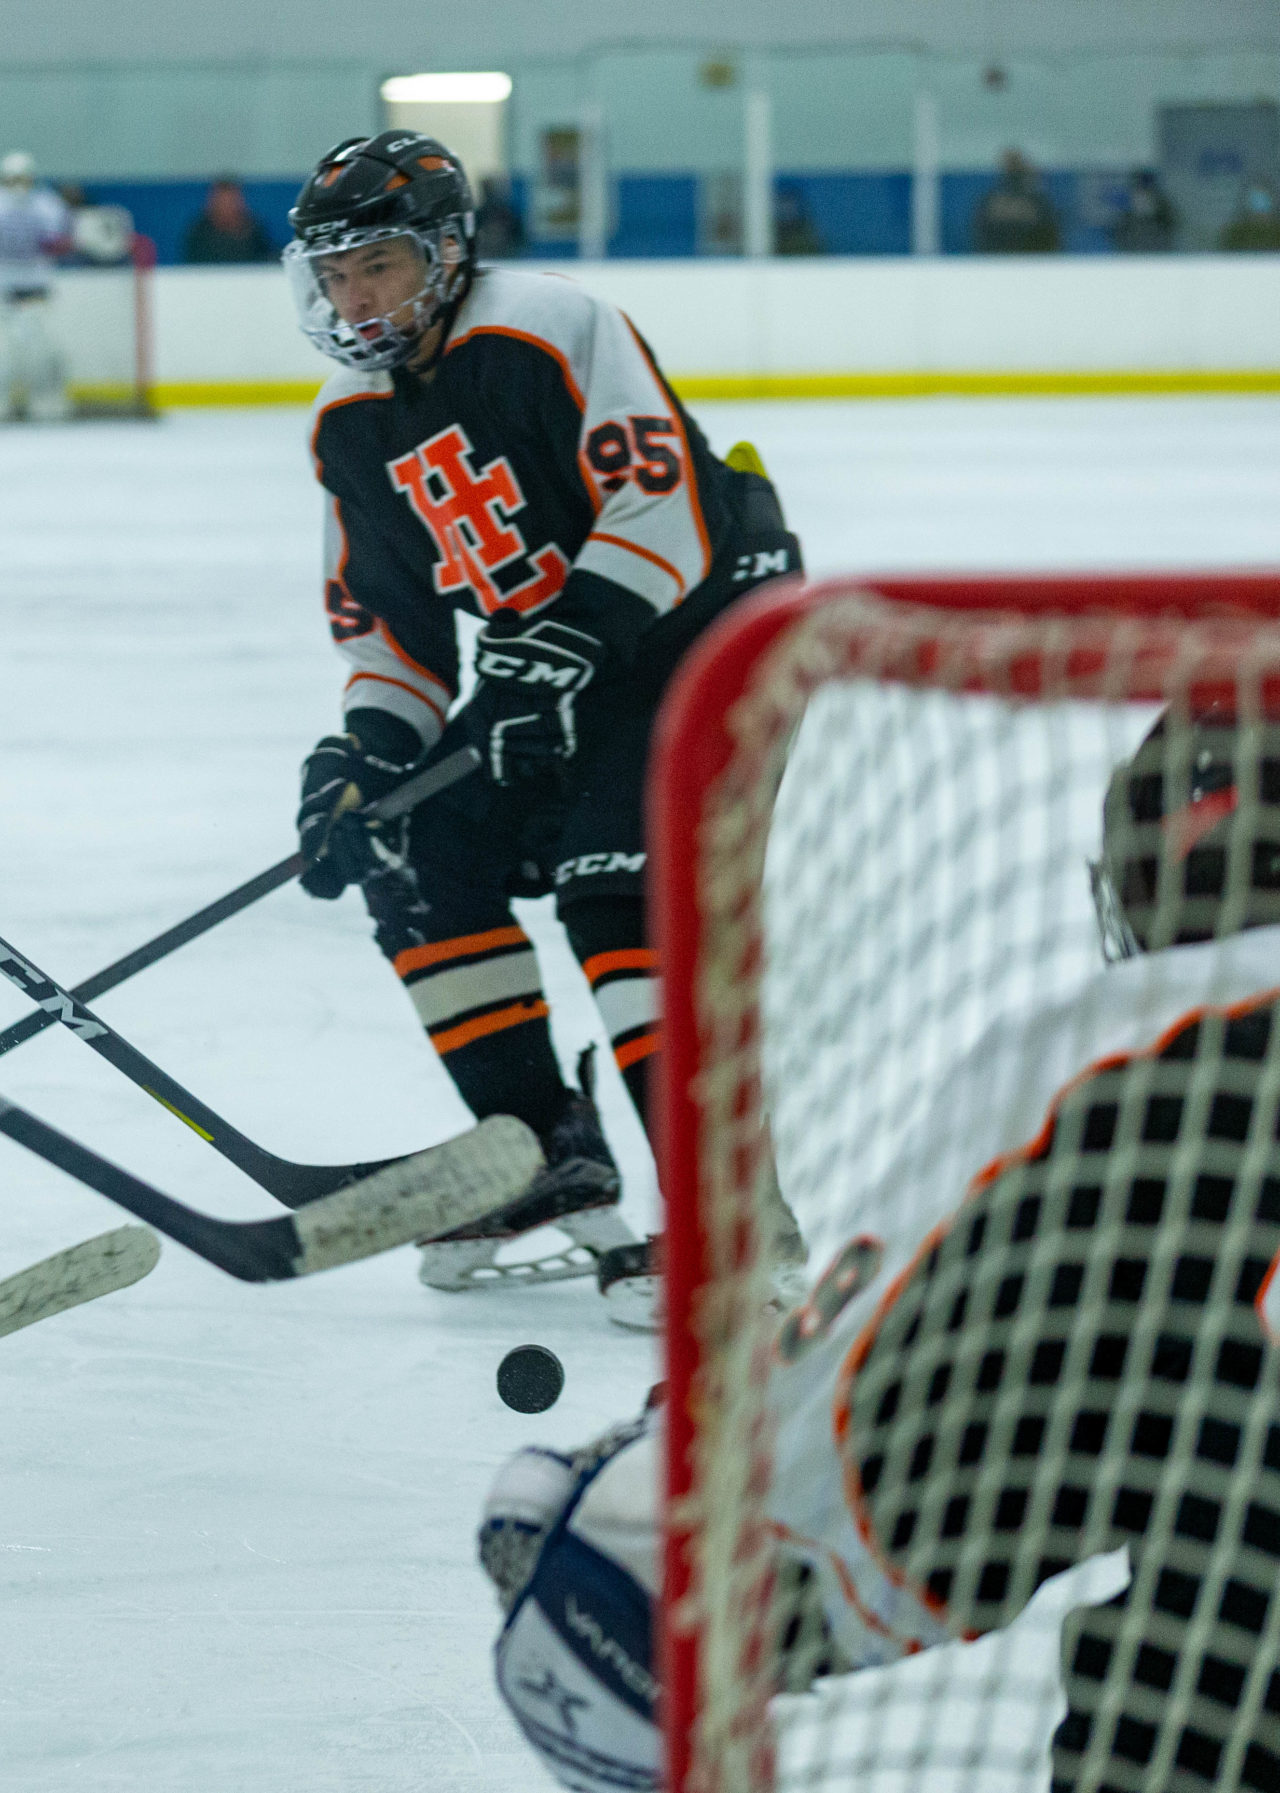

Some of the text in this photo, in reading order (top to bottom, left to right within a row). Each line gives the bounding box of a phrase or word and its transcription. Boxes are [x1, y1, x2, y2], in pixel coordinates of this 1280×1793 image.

[583, 415, 683, 496] 95
[479, 651, 580, 688] CM
[555, 851, 648, 885] CCM
